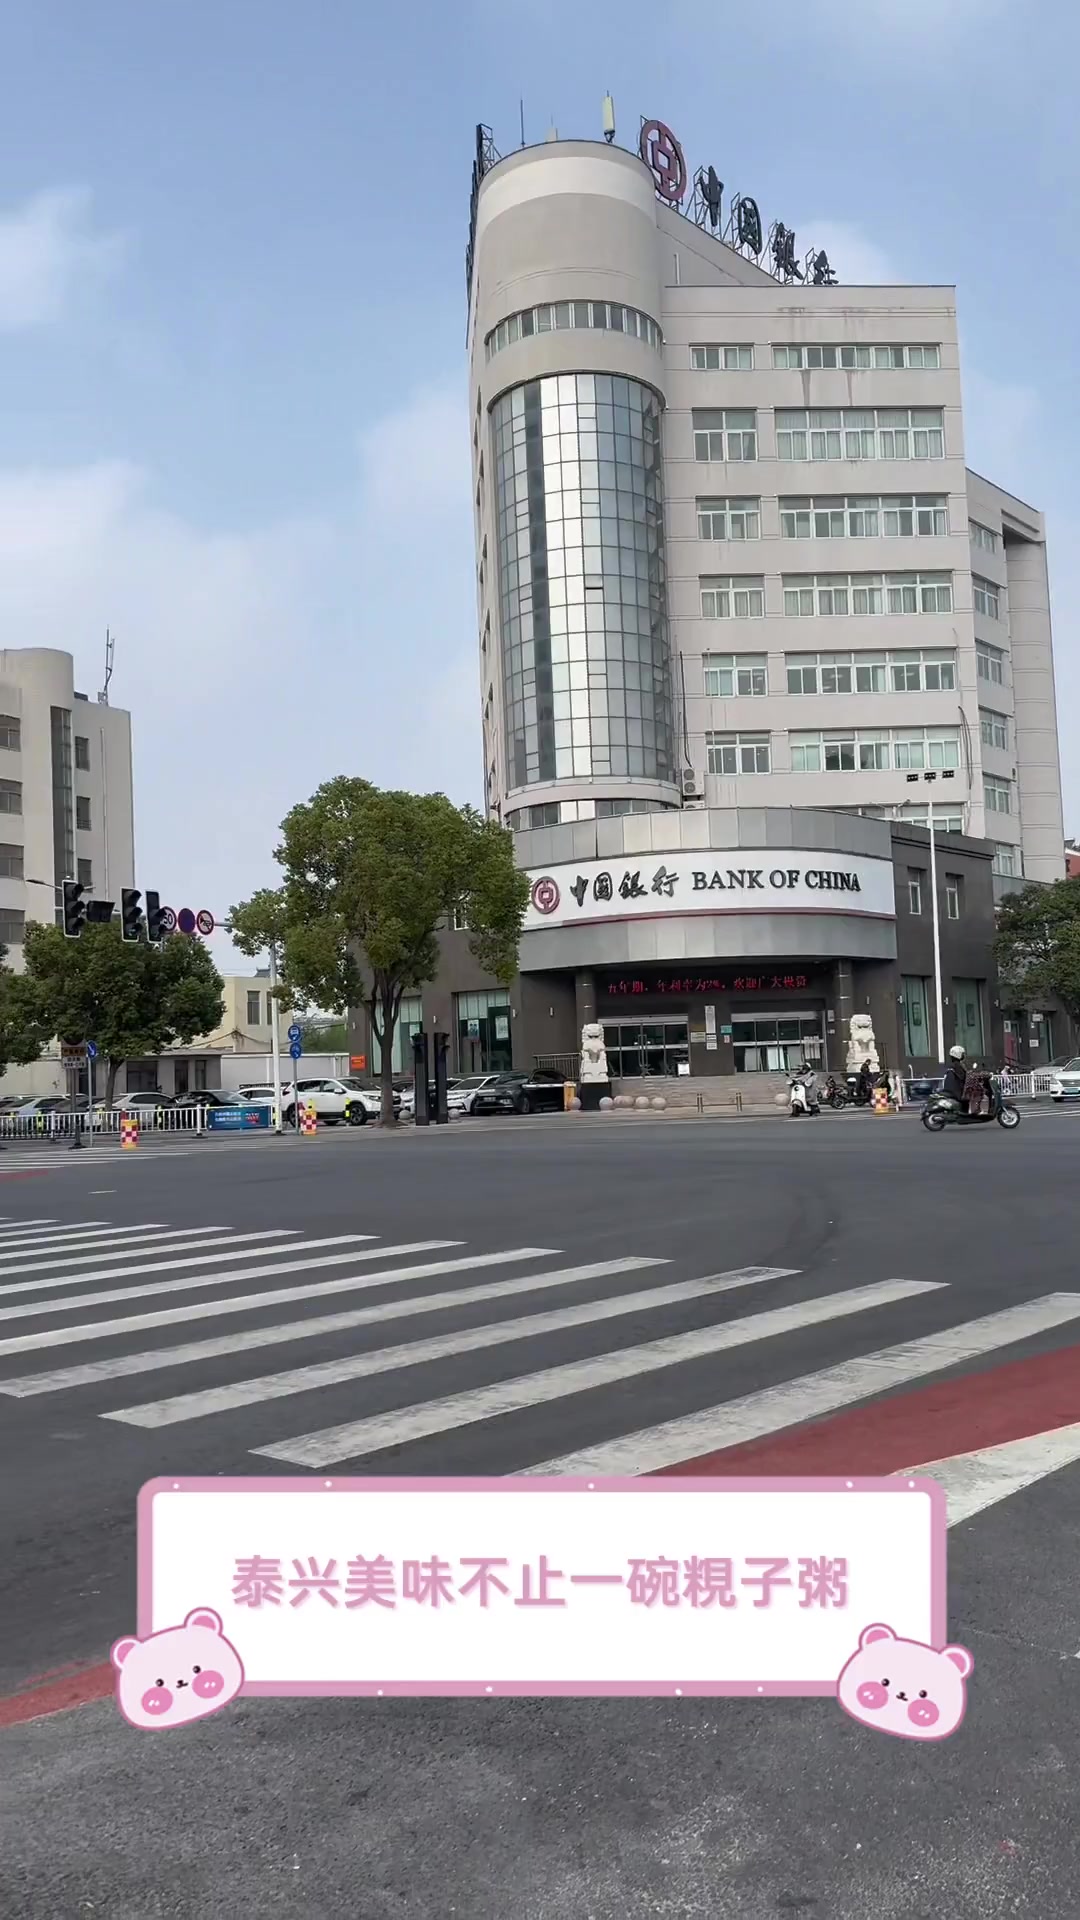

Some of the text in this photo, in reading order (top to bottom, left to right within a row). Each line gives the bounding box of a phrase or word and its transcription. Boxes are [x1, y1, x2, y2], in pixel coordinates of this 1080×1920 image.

[692, 869, 862, 892] BANK OF CHINA
